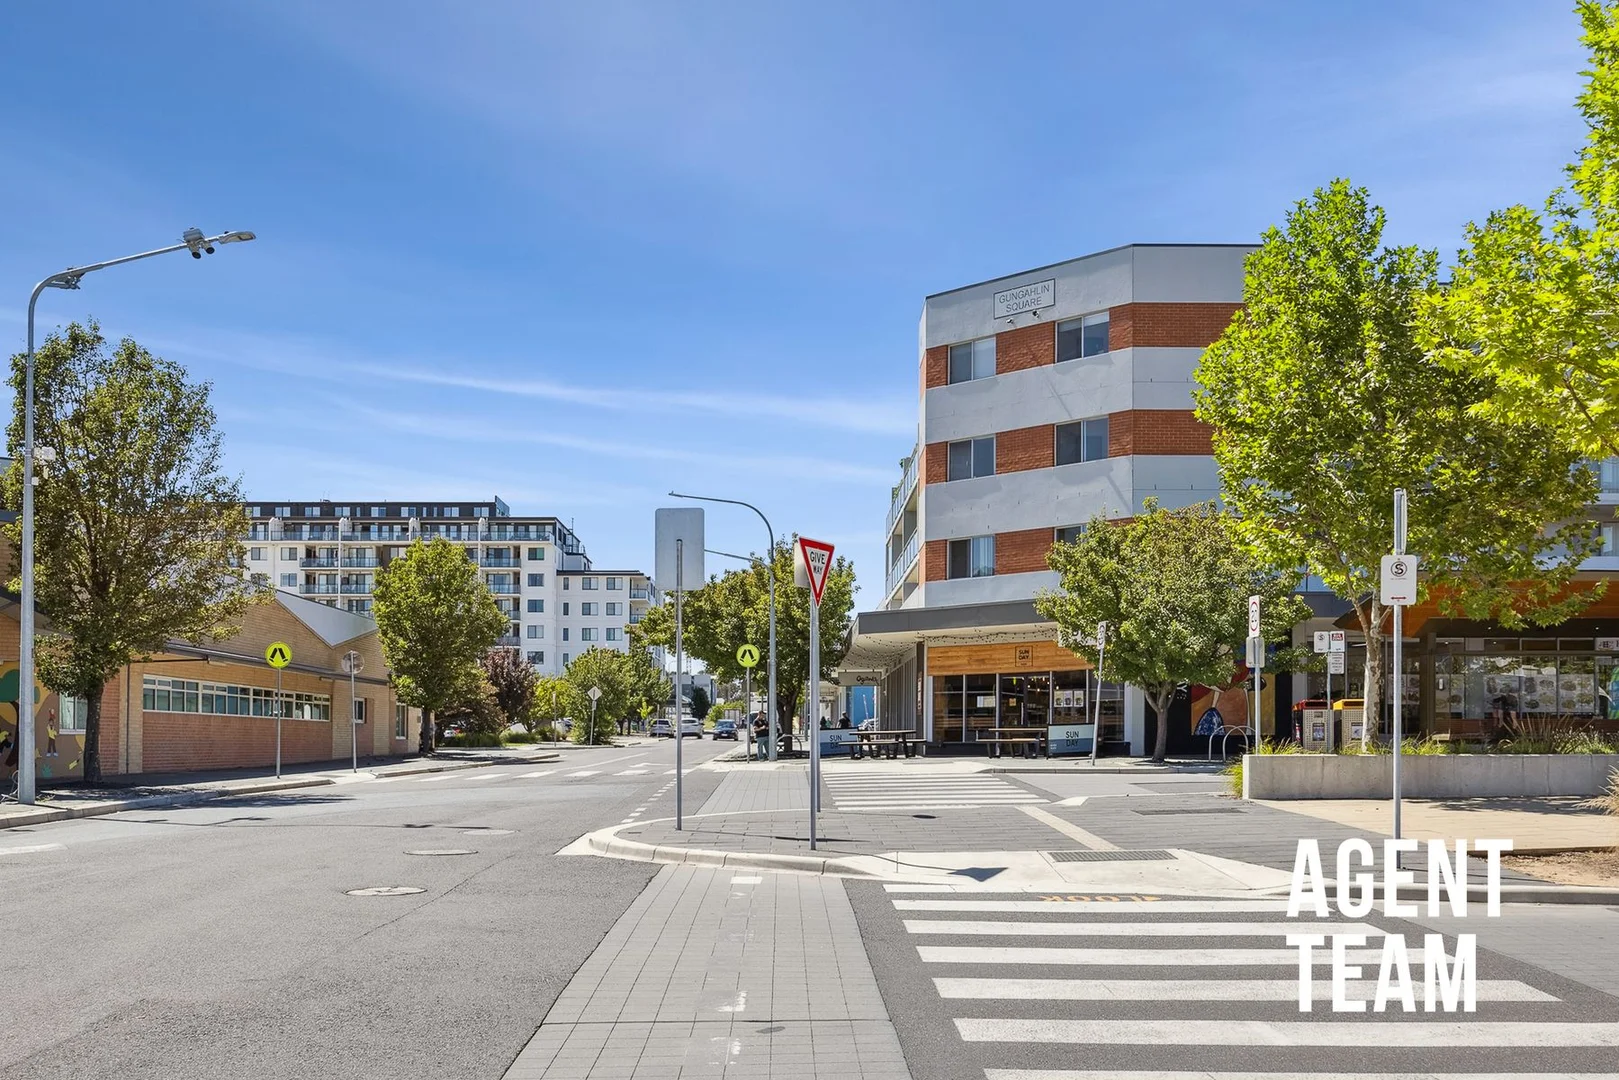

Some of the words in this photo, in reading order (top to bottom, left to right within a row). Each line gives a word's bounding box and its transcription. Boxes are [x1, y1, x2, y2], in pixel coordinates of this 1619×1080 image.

[999, 285, 1050, 304] GUNGAHLIN
[1006, 297, 1042, 312] SQUARE
[810, 551, 825, 565] GIVE
[1065, 731, 1079, 739] SUN
[1066, 739, 1079, 747] DAY
